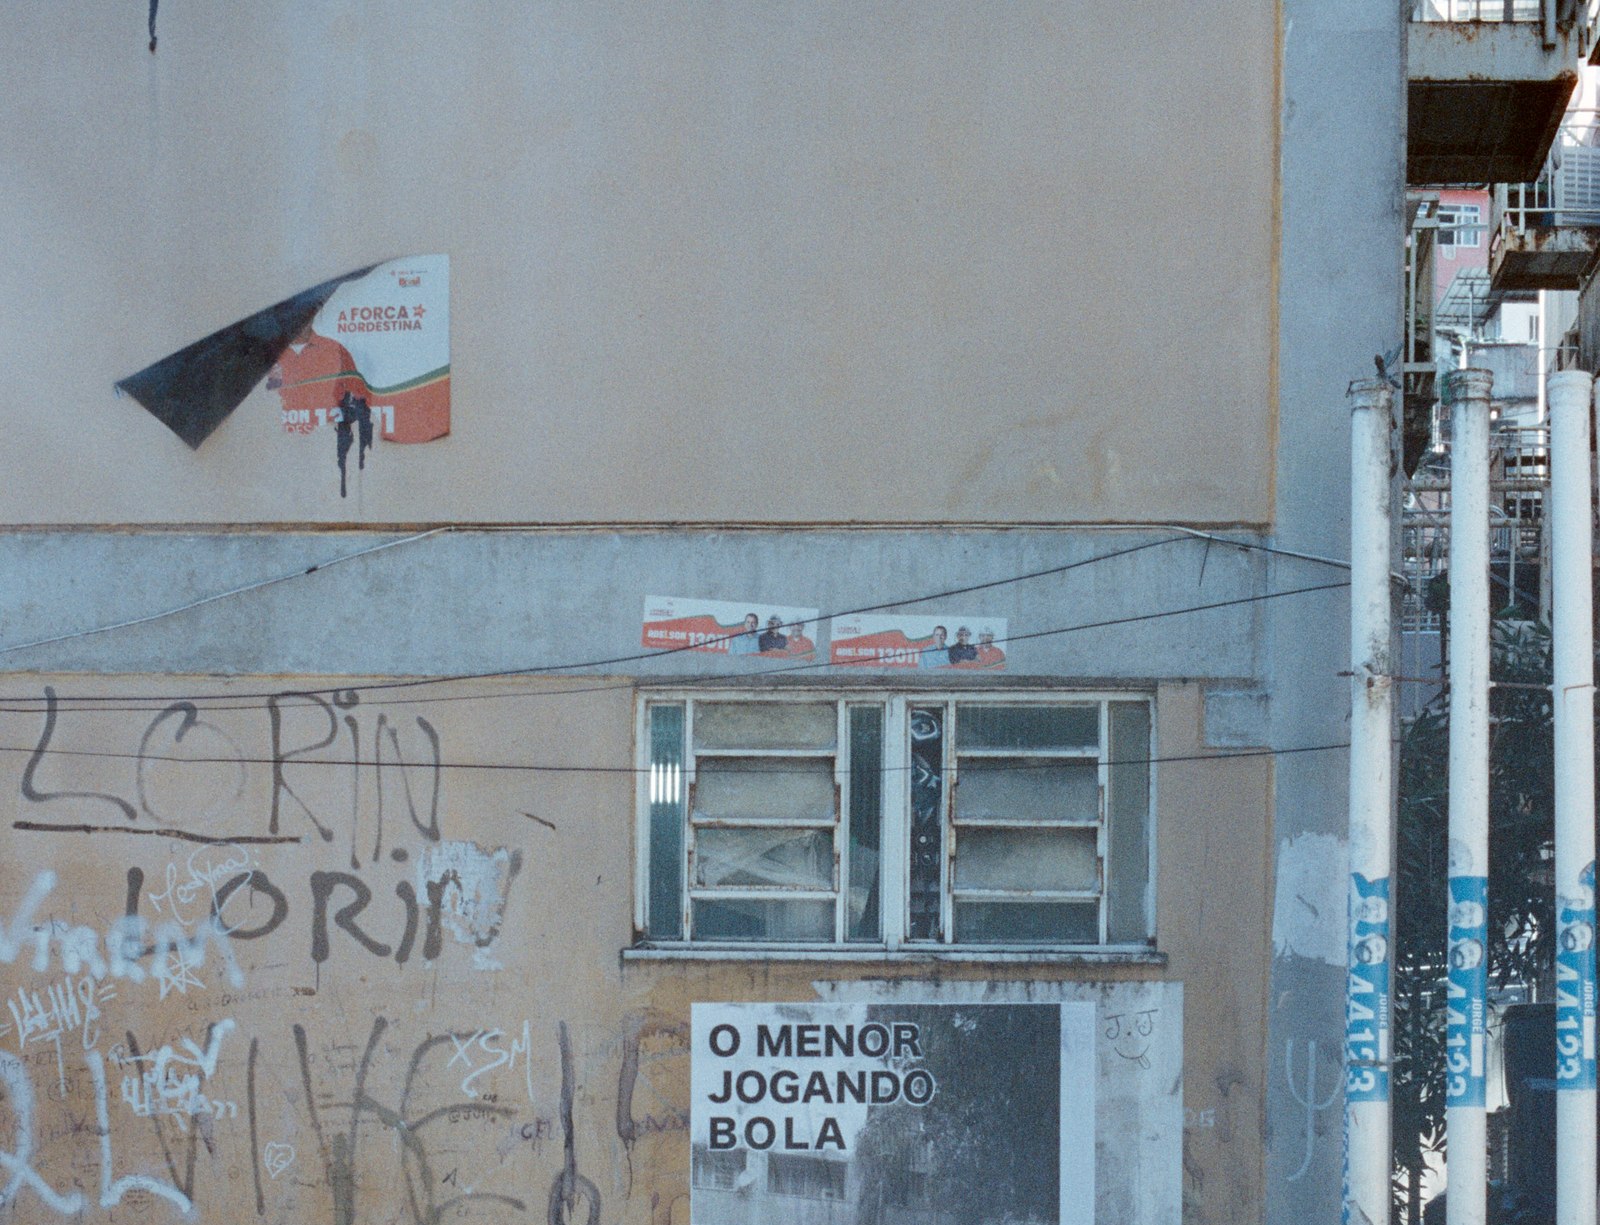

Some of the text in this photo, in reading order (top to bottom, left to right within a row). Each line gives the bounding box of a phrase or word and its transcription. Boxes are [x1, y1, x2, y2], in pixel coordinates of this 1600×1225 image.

[337, 319, 422, 334] NORDESTINA
[338, 310, 347, 322] A
[1378, 992, 1388, 1029] JORGE
[1472, 997, 1482, 1033] JORGE
[1584, 979, 1595, 1017] JORGE
[708, 1023, 922, 1058] O MENOR
[1348, 973, 1376, 1093] 44123
[707, 1069, 935, 1105] JOGANDO
[708, 1116, 848, 1151] BOLA
